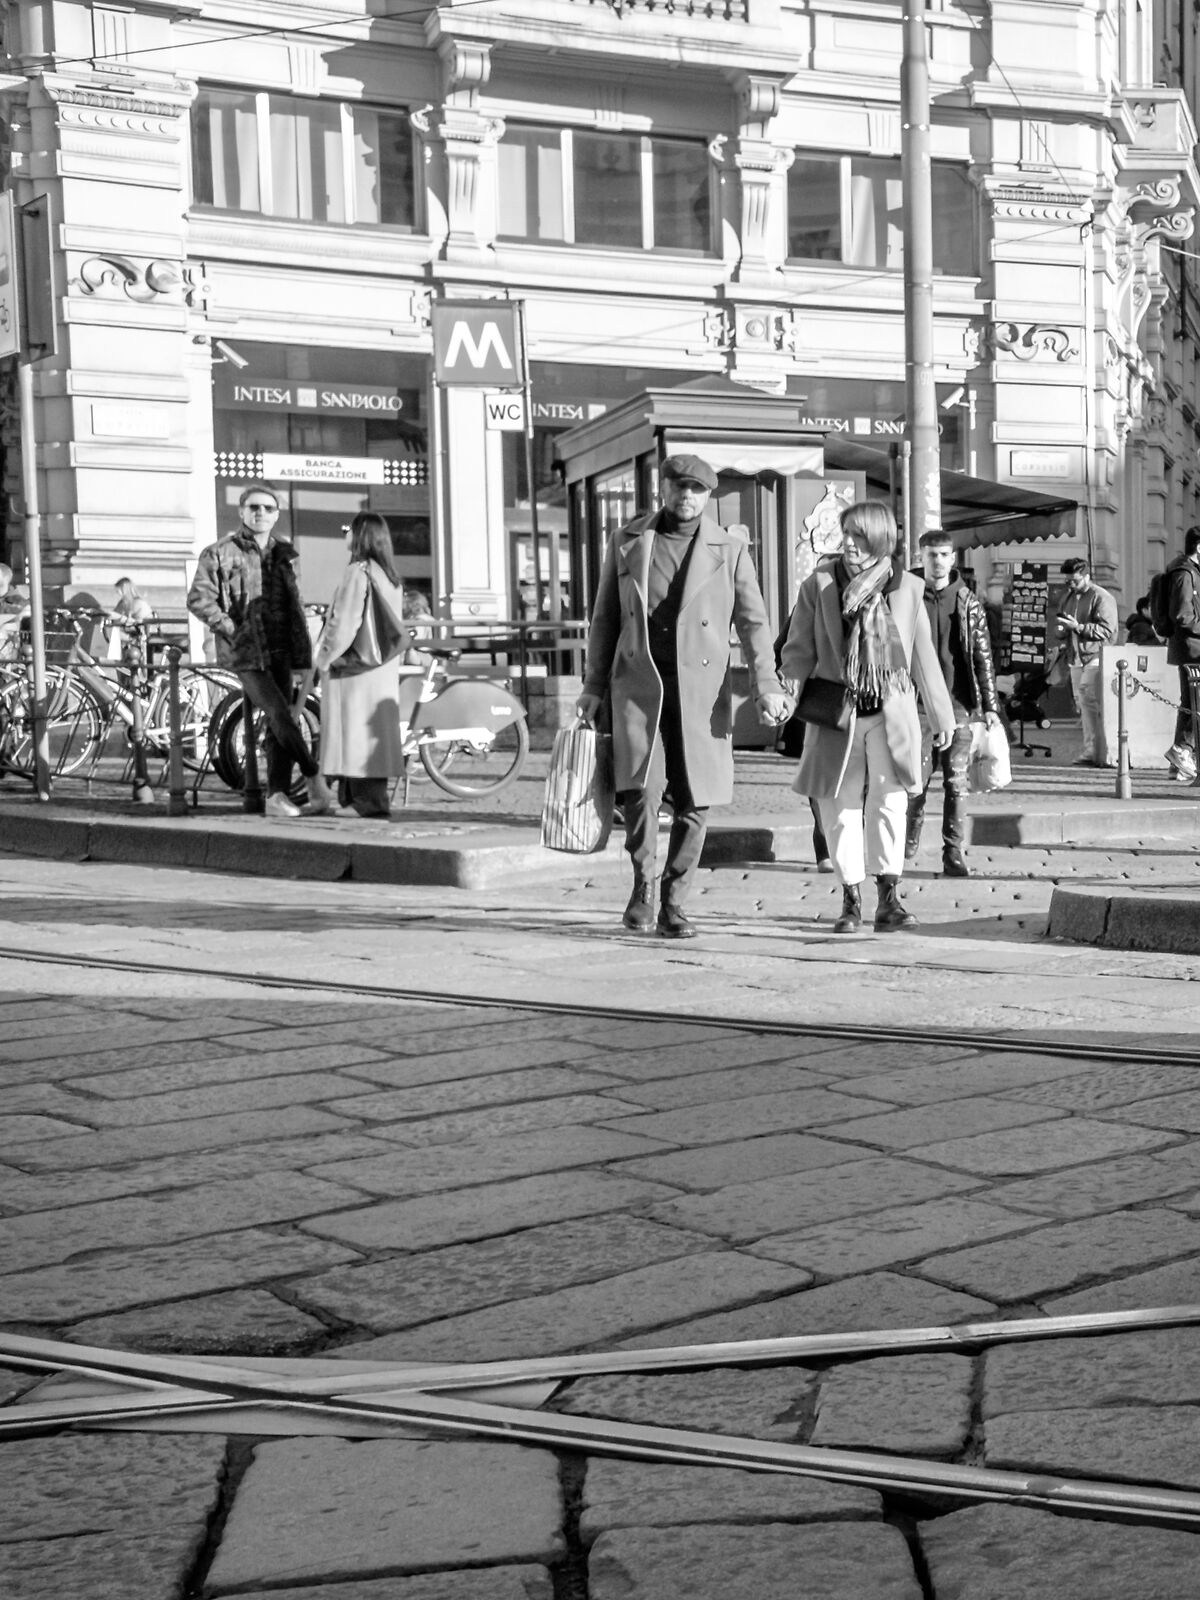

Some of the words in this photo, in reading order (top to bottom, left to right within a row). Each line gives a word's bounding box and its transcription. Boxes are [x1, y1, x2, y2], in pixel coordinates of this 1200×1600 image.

[444, 320, 512, 369] M
[234, 385, 291, 404] INTESA
[321, 391, 403, 411] SANPAOLO
[489, 404, 520, 420] WC
[532, 402, 584, 420] INTESA
[305, 459, 342, 468] BANCA
[280, 469, 367, 480] ASSICURAZIONE
